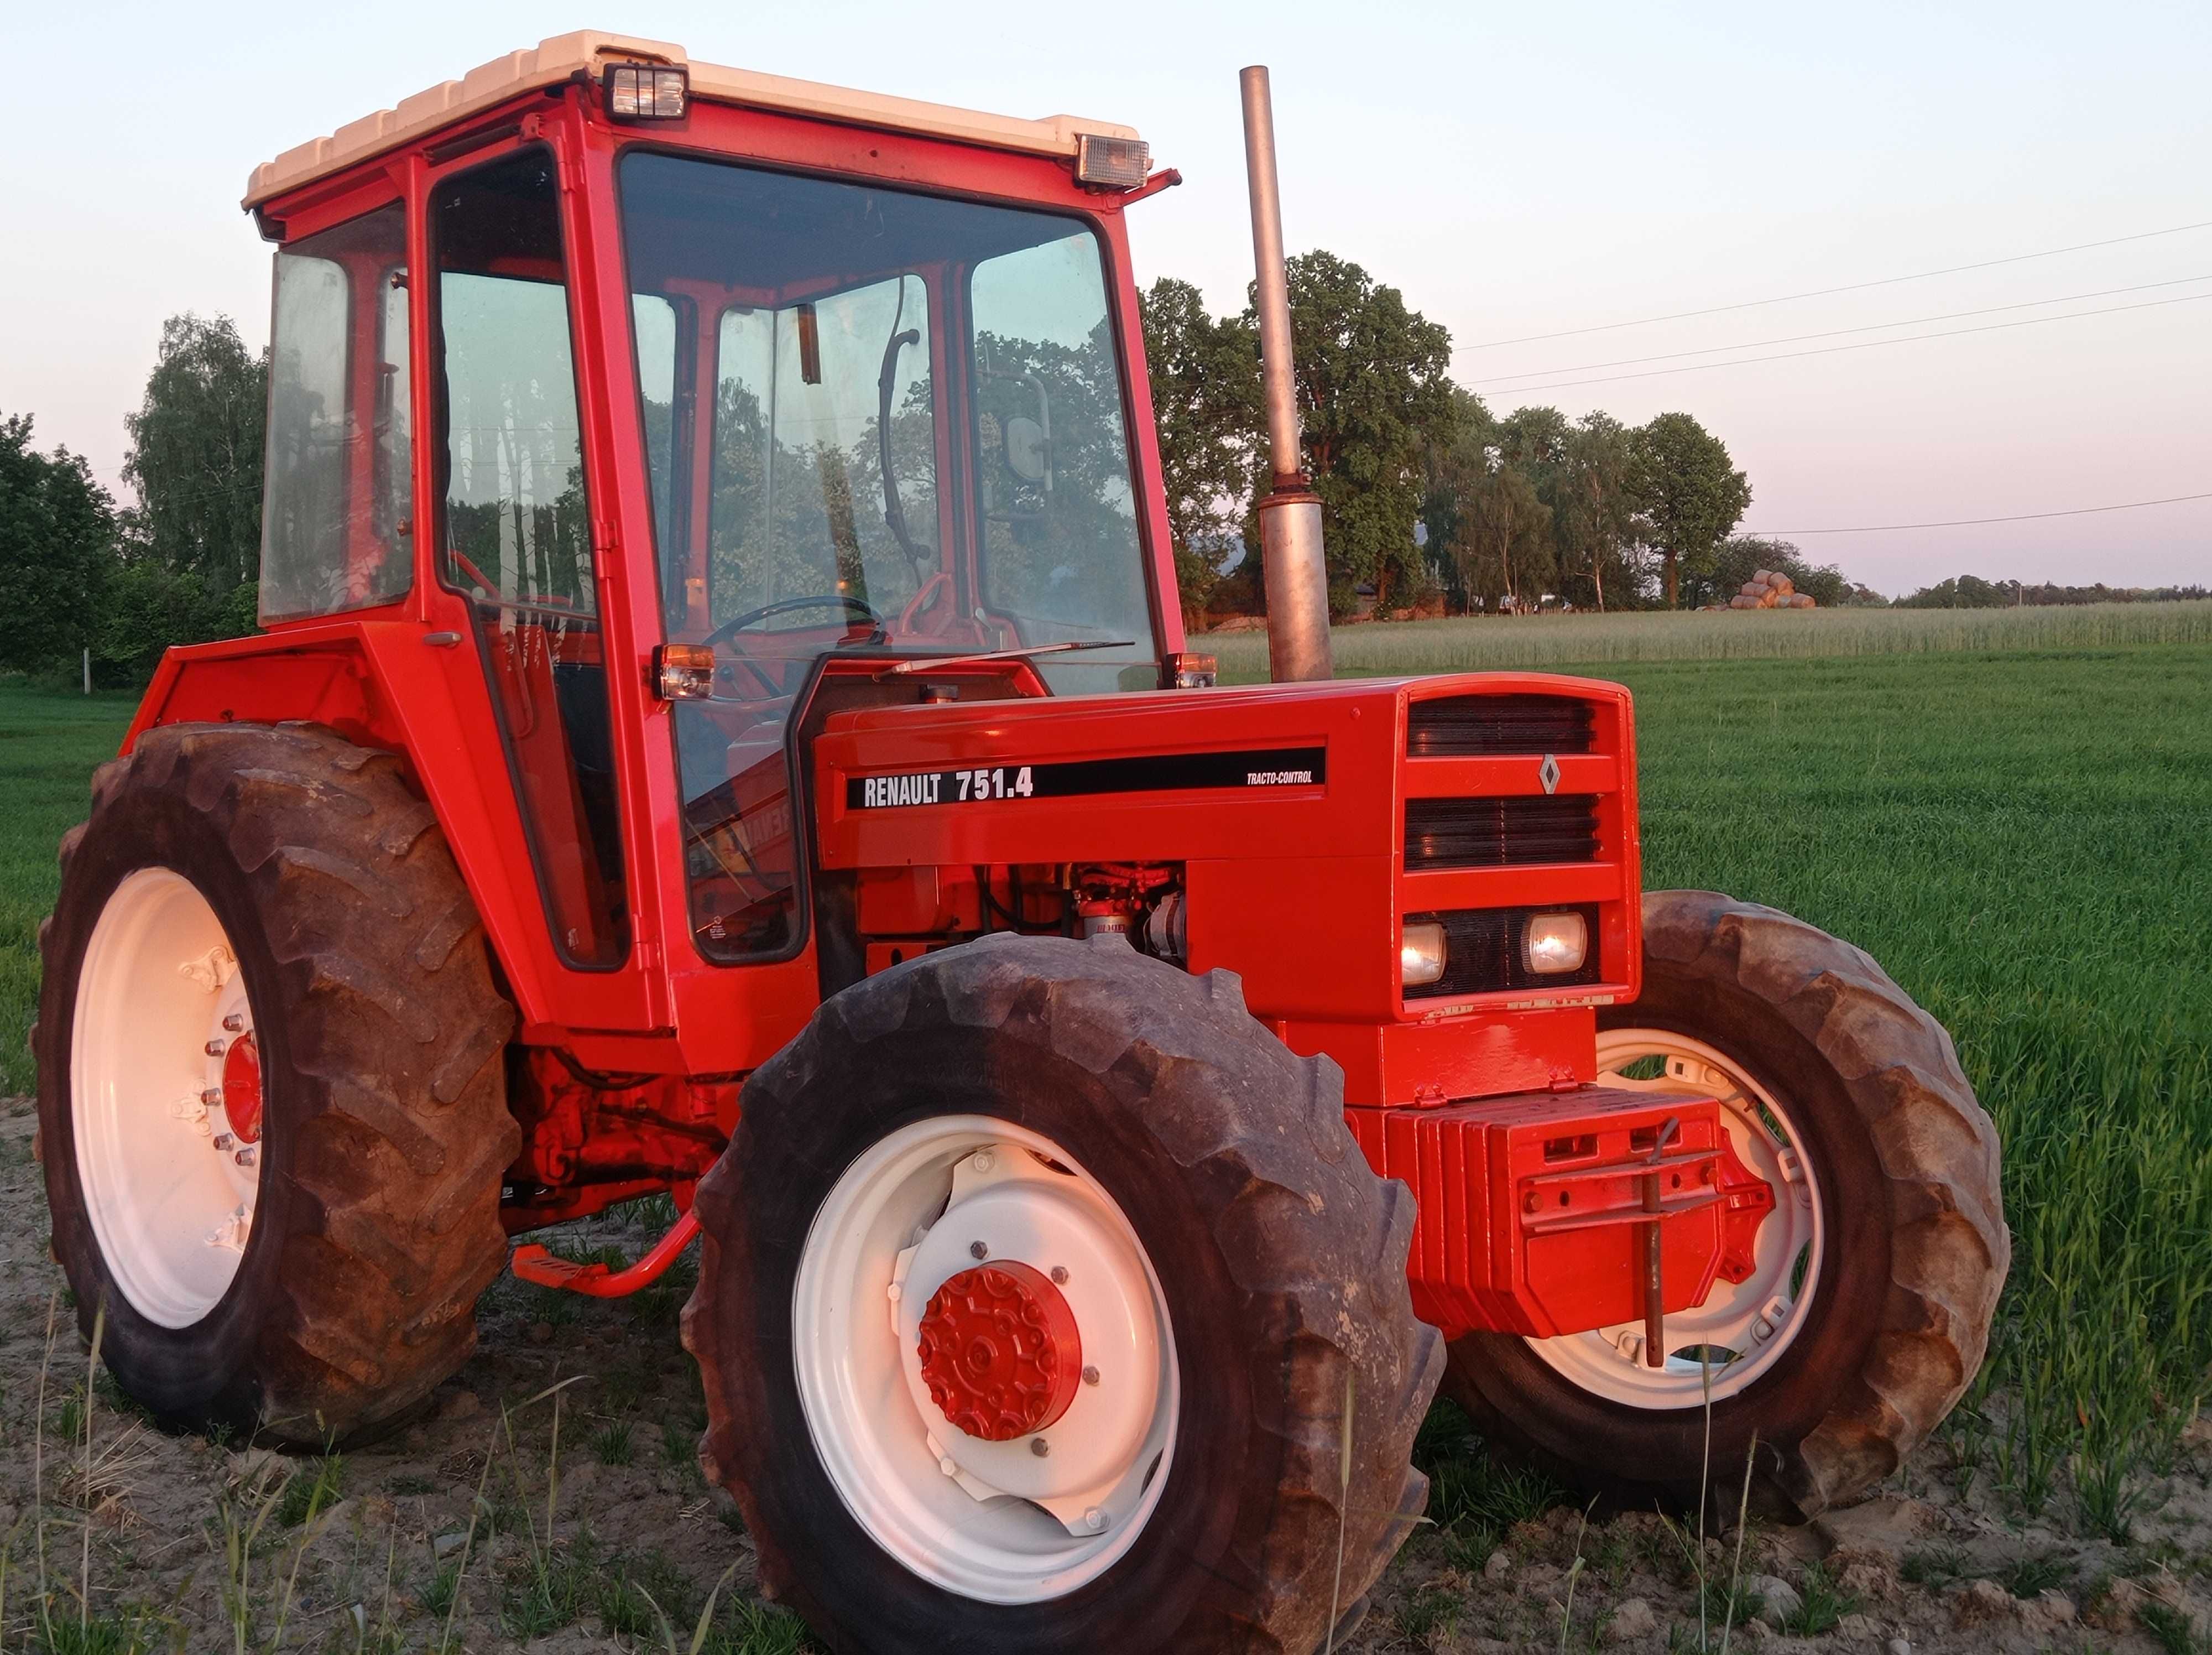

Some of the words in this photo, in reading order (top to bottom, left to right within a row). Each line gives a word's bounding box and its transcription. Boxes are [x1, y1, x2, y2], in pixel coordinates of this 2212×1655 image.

[864, 774, 941, 807] RENAULT
[956, 767, 1033, 801] 751.4
[1247, 771, 1312, 785] TRACTO-CONTROL
